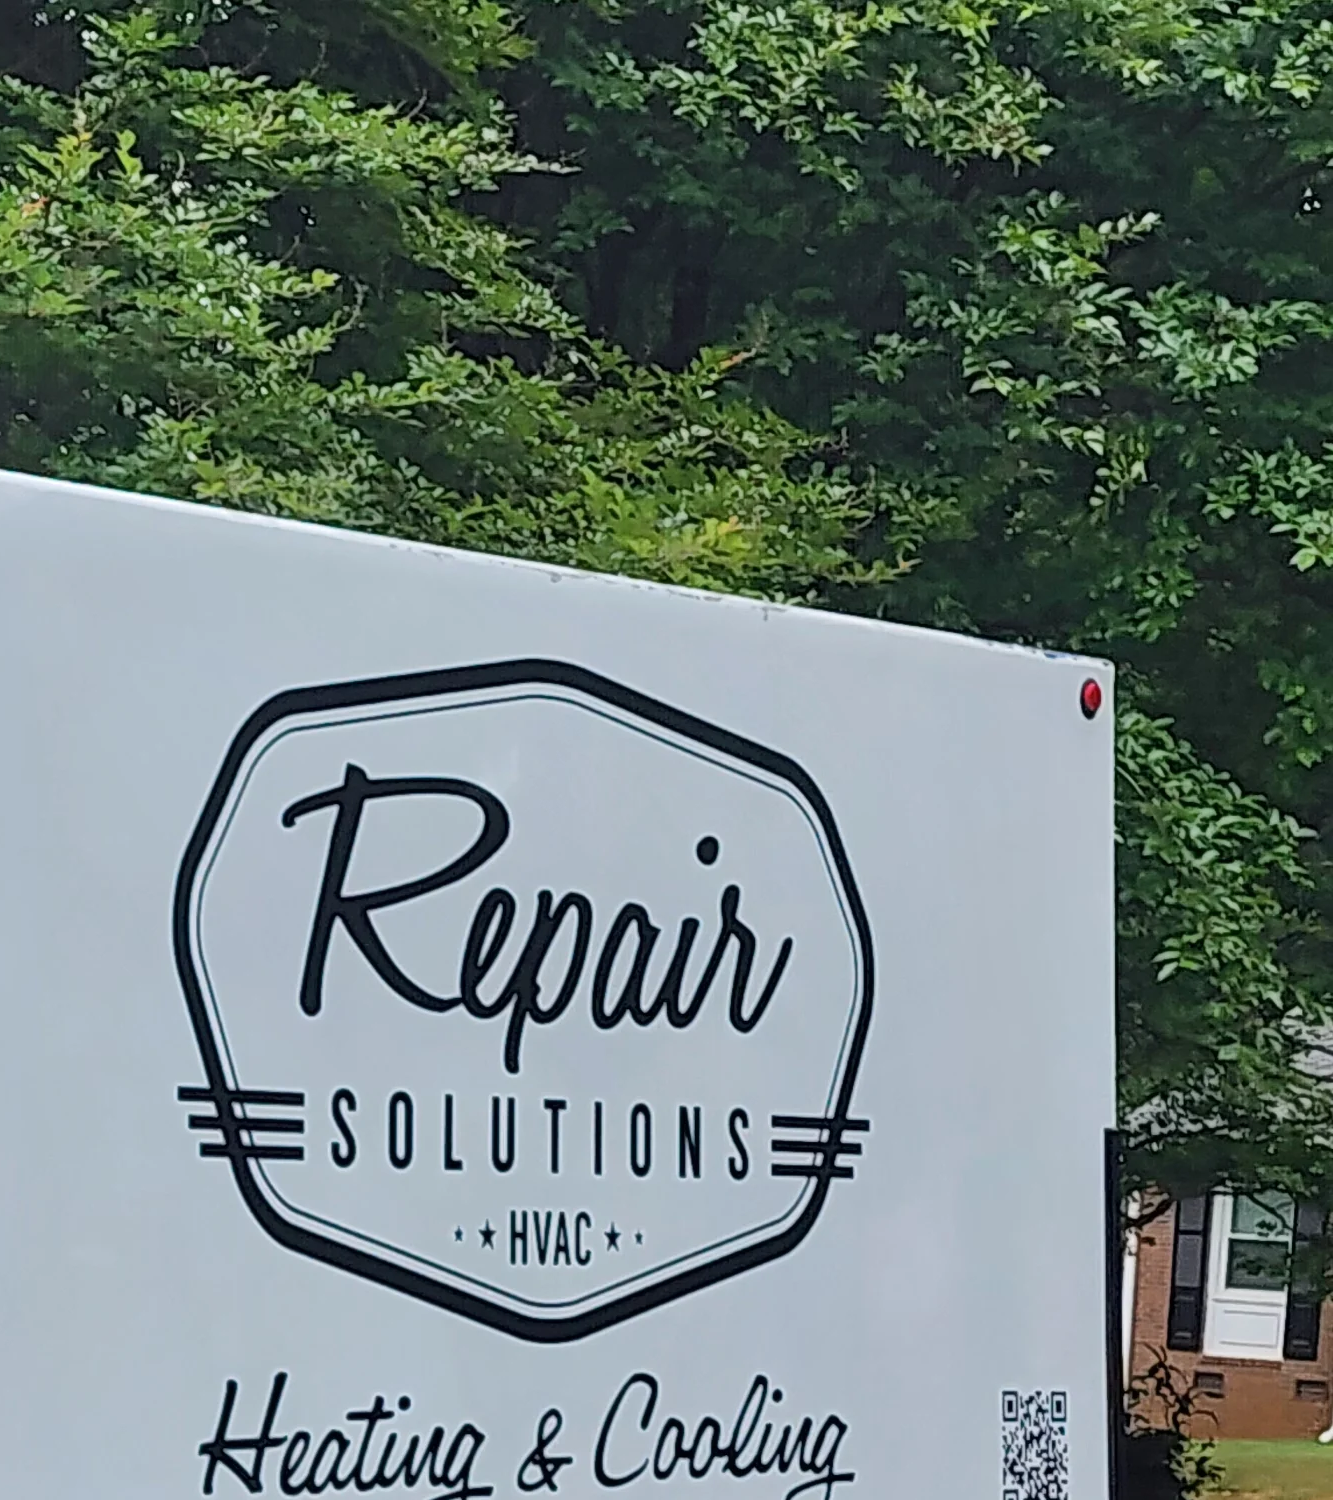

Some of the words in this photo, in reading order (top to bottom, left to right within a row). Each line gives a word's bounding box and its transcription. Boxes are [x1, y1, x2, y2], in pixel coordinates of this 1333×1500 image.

[281, 762, 793, 1075] Repair
[331, 1088, 750, 1181] SOLUTIONS
[509, 1210, 593, 1266] HVAC
[517, 1408, 573, 1492] &
